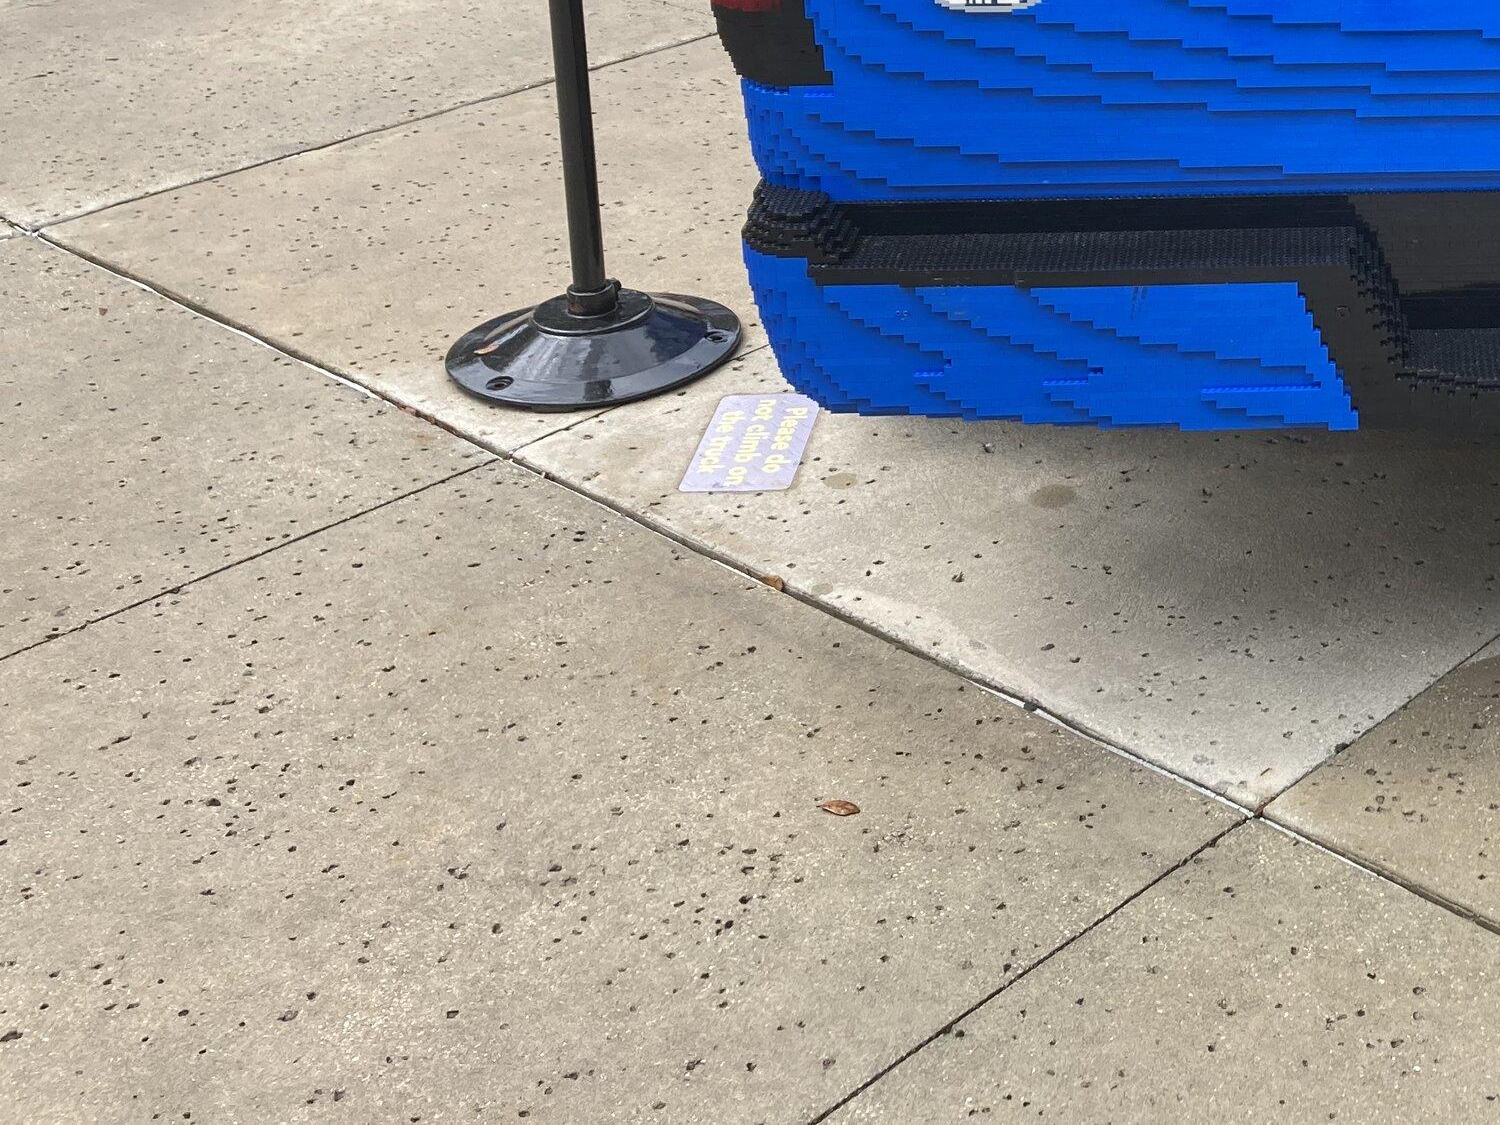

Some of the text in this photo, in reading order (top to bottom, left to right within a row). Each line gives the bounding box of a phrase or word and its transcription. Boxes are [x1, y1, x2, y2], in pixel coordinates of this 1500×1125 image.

[696, 410, 746, 474] the truck
[722, 399, 777, 488] not climb on
[761, 407, 808, 473] Please do
